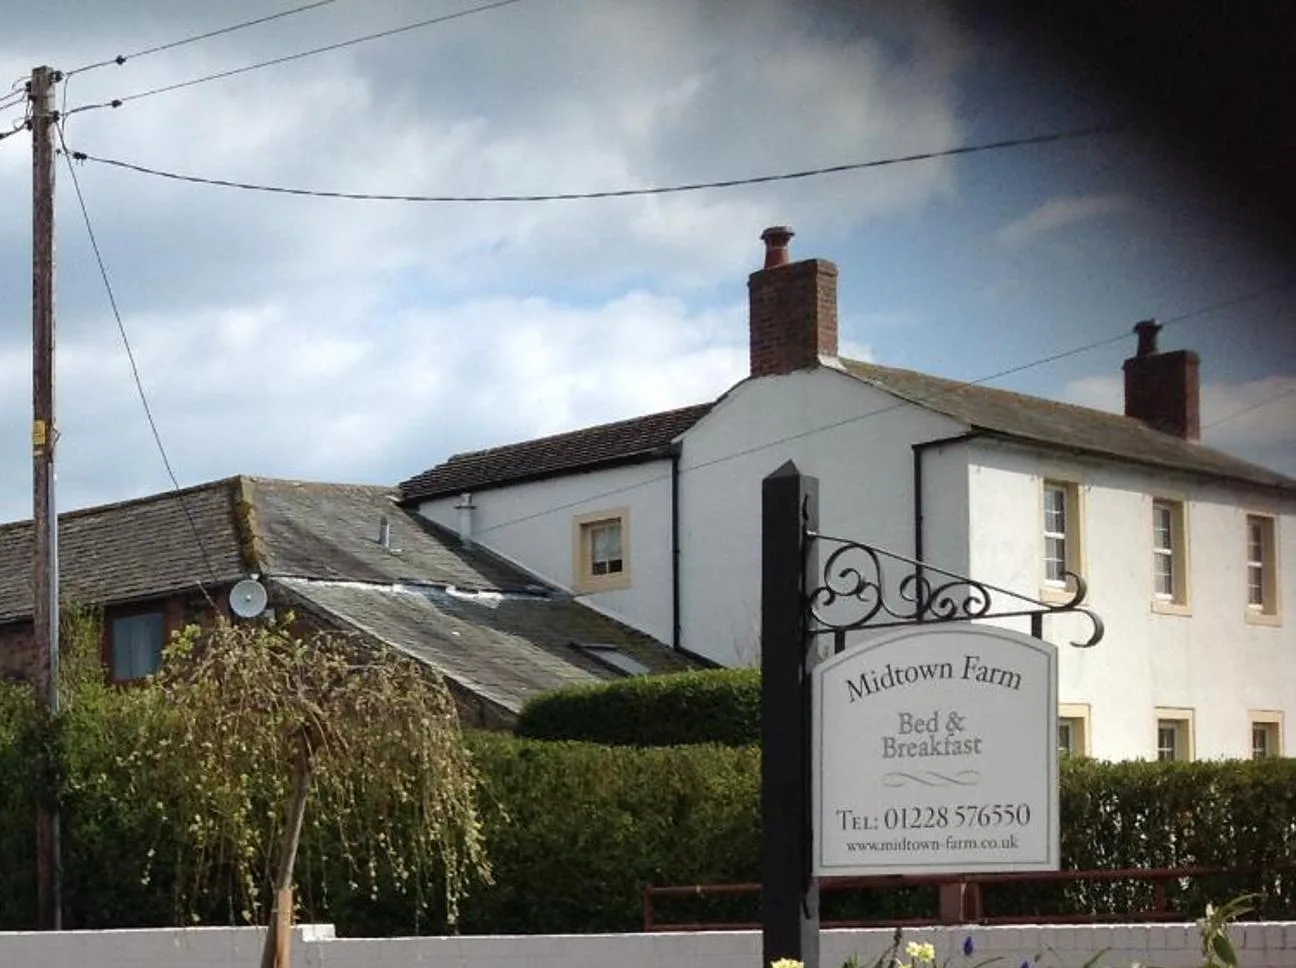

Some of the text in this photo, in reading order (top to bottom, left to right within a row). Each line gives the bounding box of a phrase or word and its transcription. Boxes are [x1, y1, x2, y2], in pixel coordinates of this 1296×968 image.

[845, 654, 1023, 704] Midtown Farm
[898, 710, 967, 736] Bed &
[882, 733, 983, 759] Breakfast
[883, 806, 949, 830] 01228
[954, 803, 1032, 828] 576550
[846, 834, 1020, 852] www.midtown-farm.co.uk
